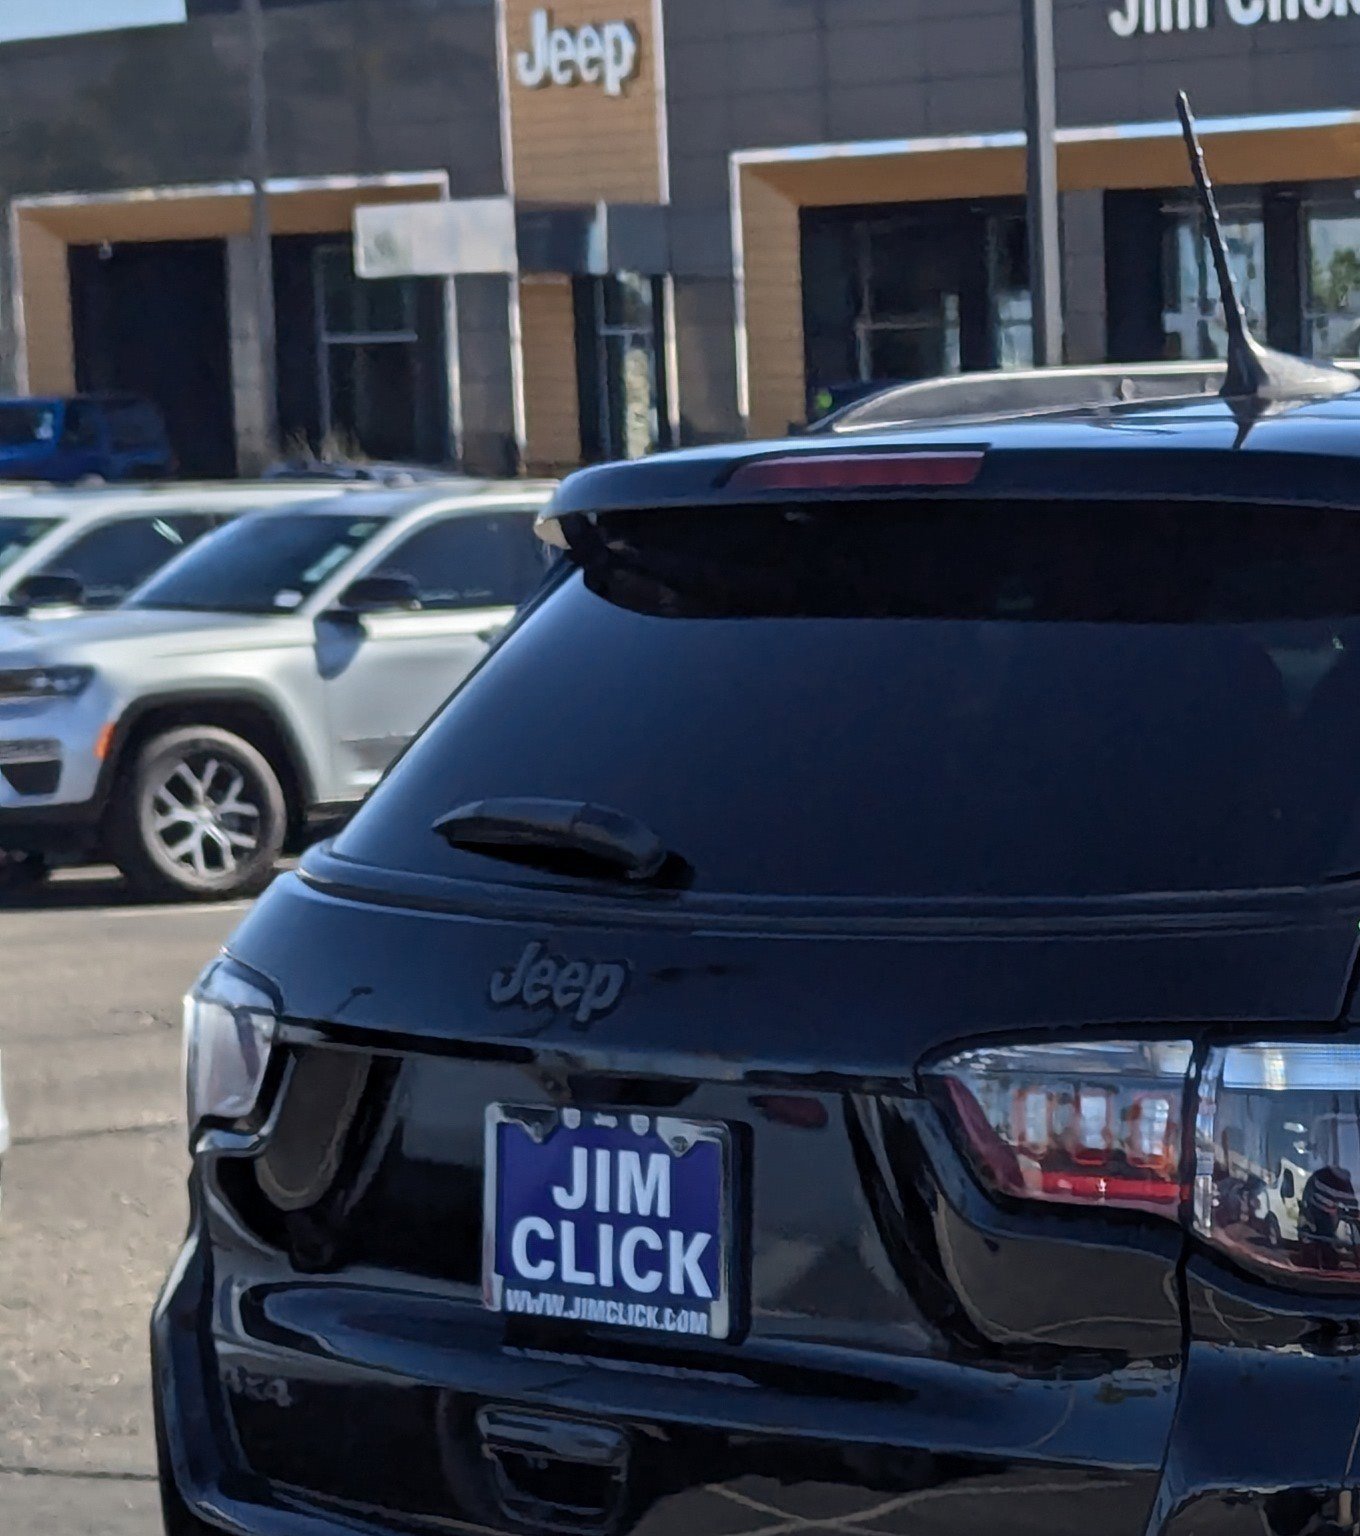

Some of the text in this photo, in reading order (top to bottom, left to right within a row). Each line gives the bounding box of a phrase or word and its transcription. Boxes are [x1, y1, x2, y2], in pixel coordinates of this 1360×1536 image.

[516, 8, 636, 95] Jeep
[490, 942, 625, 1022] Jeep
[552, 1146, 670, 1218] JIM
[511, 1216, 713, 1299] CLICK
